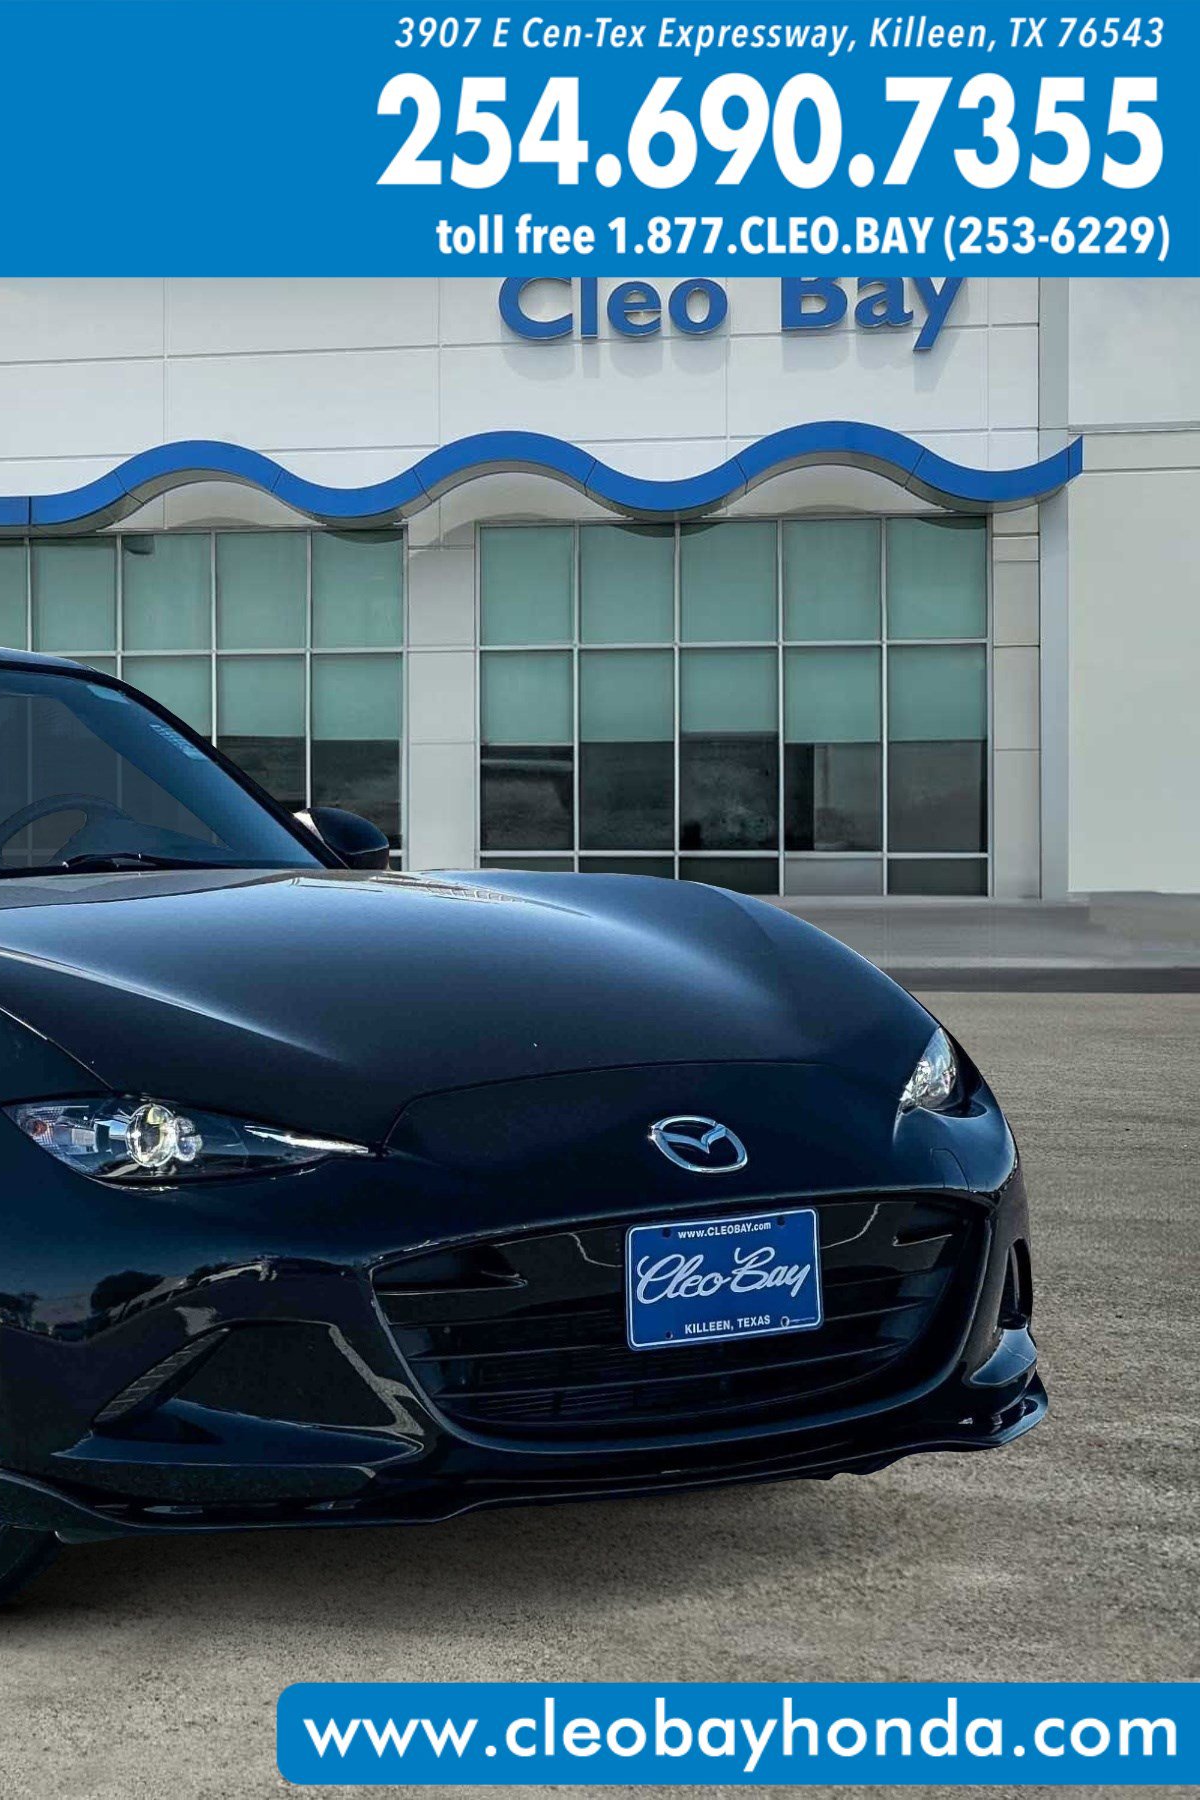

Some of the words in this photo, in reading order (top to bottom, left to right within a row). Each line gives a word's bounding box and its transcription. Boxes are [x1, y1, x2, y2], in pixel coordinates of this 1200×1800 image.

[498, 278, 729, 340] Cleo
[781, 278, 965, 350] Bay
[677, 1222, 772, 1239] www.CLEOBAY.com
[637, 1253, 731, 1305] Cleo
[730, 1246, 811, 1298] Bay
[684, 1318, 735, 1336] KILLEEN,
[737, 1314, 772, 1329] TEXAS
